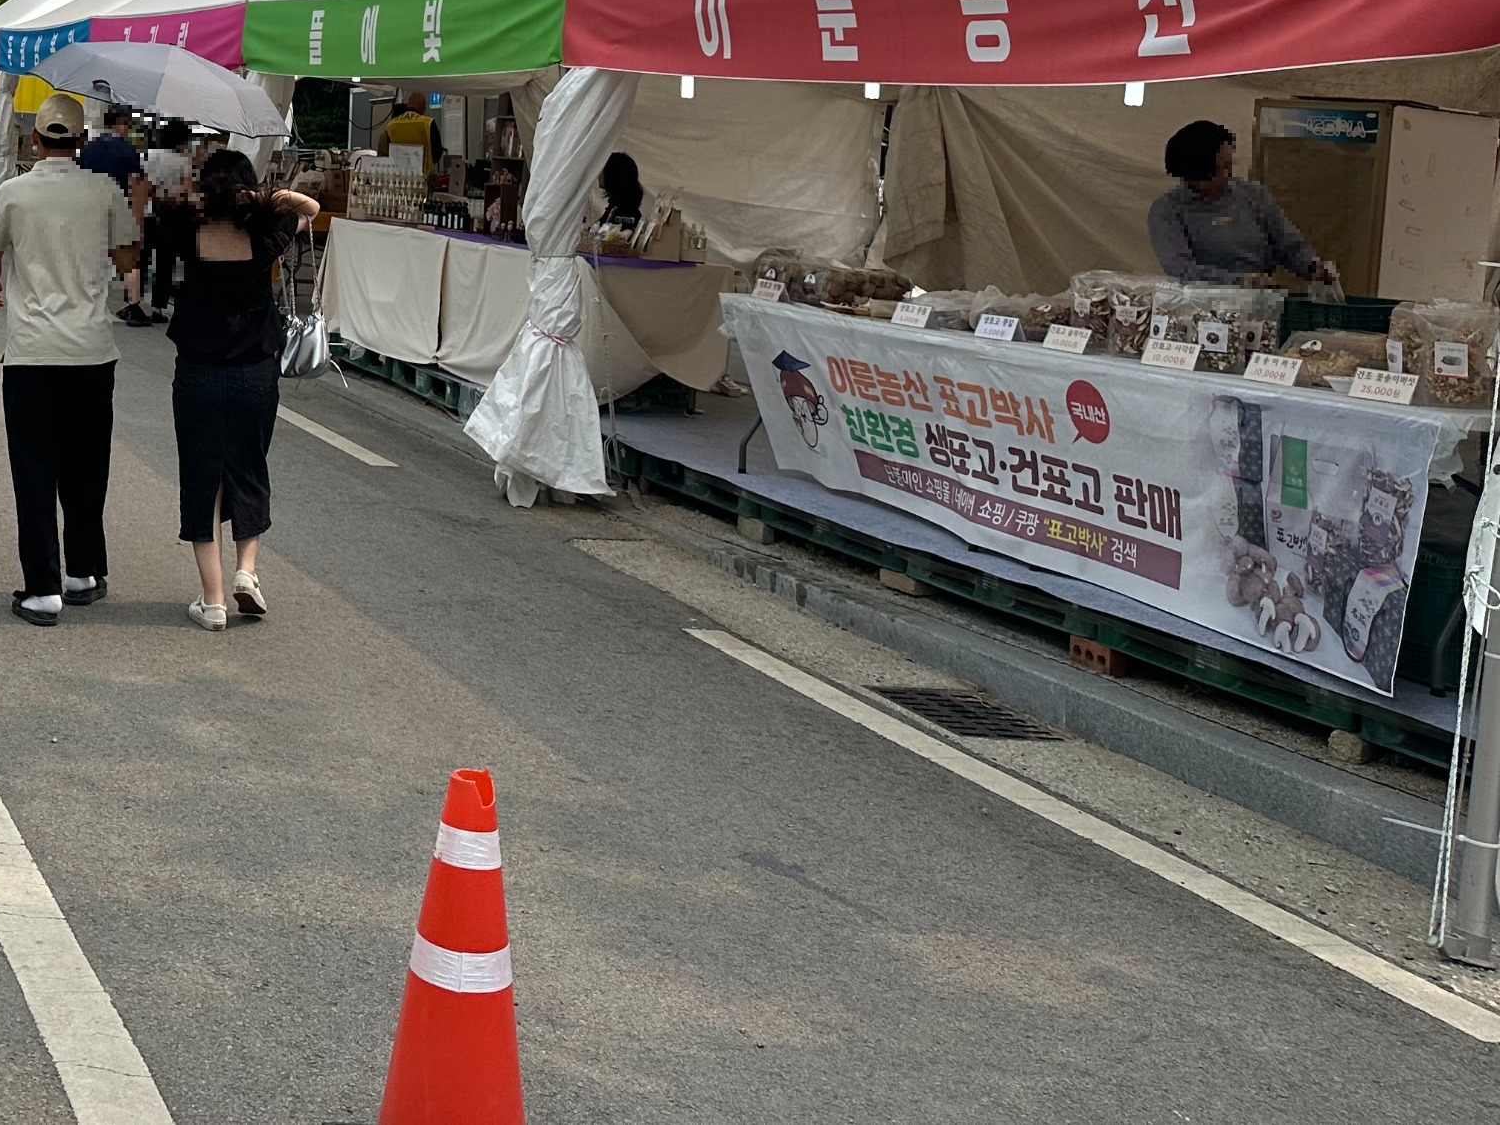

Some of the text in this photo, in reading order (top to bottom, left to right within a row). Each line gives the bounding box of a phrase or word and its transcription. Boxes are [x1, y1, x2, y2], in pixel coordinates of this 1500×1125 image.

[826, 356, 1055, 444] 이룬농산 표고박사
[1070, 401, 1107, 425] 국내산
[1375, 372, 1416, 386] 꽃송이버섯
[840, 404, 920, 458] 친환경
[1112, 473, 1183, 541] 판매
[883, 464, 923, 493] 단풍미인
[926, 477, 951, 504] 쇼핑몰
[955, 487, 975, 516] 네이버
[977, 500, 1006, 525] 쇼핑
[1015, 510, 1040, 536] 쿠팡
[1111, 537, 1138, 568] 검색
